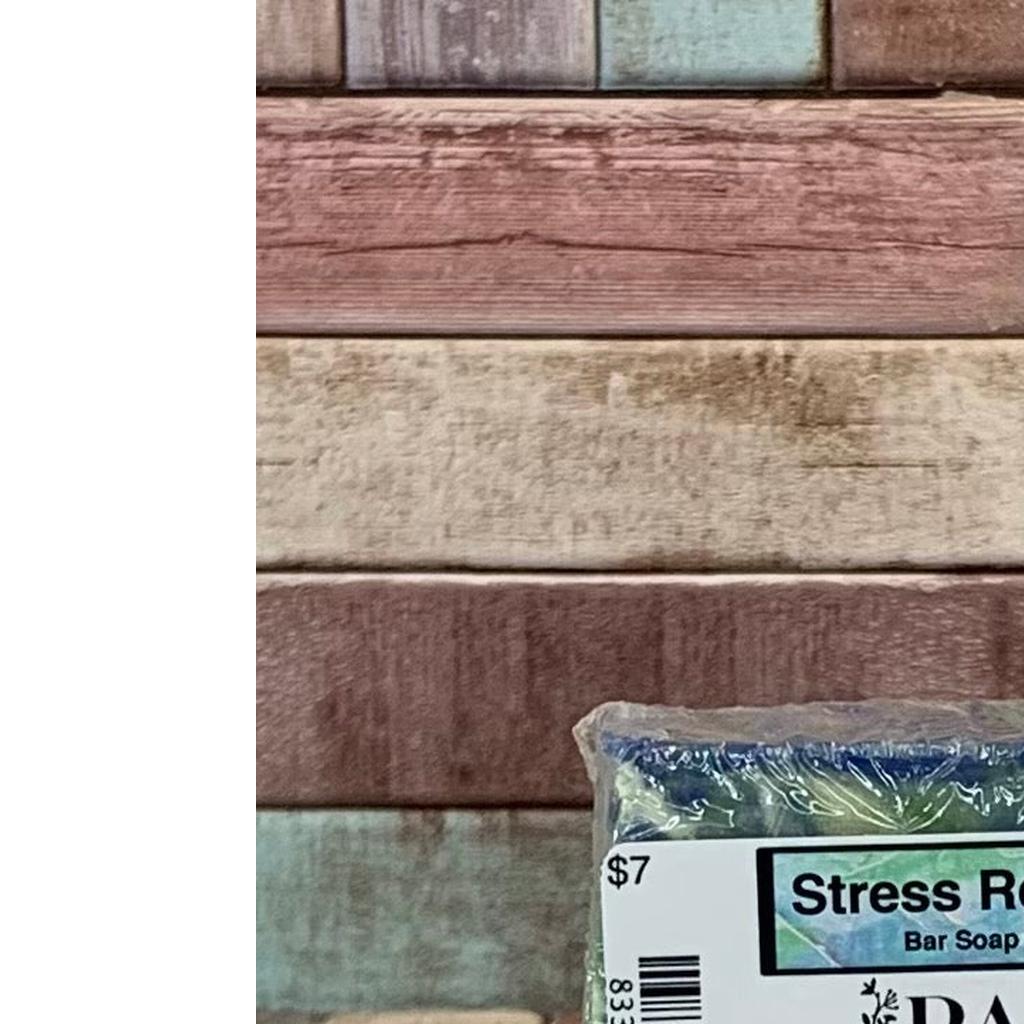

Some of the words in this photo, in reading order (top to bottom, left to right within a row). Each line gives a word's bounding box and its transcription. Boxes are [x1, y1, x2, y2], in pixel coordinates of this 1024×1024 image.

[606, 855, 650, 889] $7
[791, 872, 962, 915] Stress
[904, 930, 947, 951] Bar
[955, 928, 1020, 954] Soap
